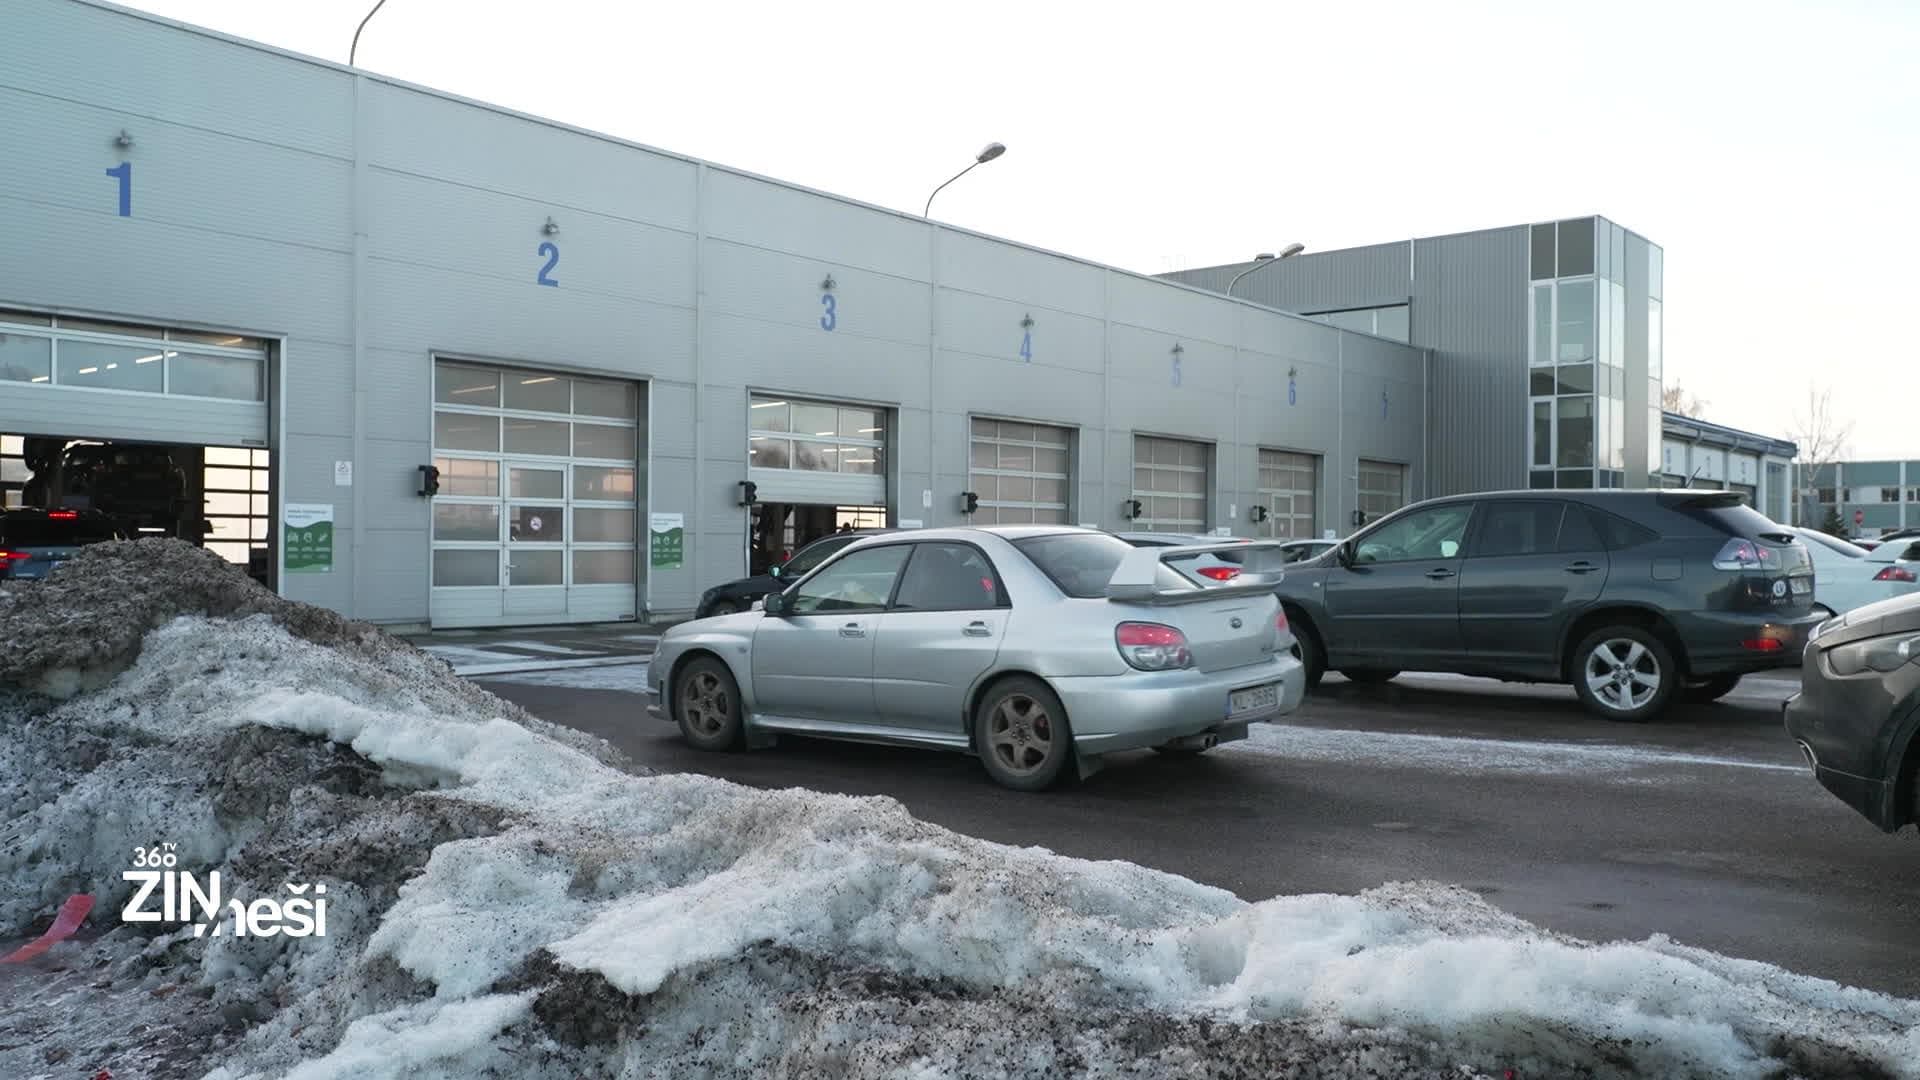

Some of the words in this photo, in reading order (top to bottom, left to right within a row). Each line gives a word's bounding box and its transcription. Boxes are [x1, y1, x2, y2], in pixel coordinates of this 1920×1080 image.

[106, 162, 131, 217] 1
[537, 241, 560, 288] 2
[820, 293, 837, 332] 3
[1019, 332, 1033, 363] 4
[1171, 358, 1182, 388] 5
[1287, 380, 1297, 406] 6
